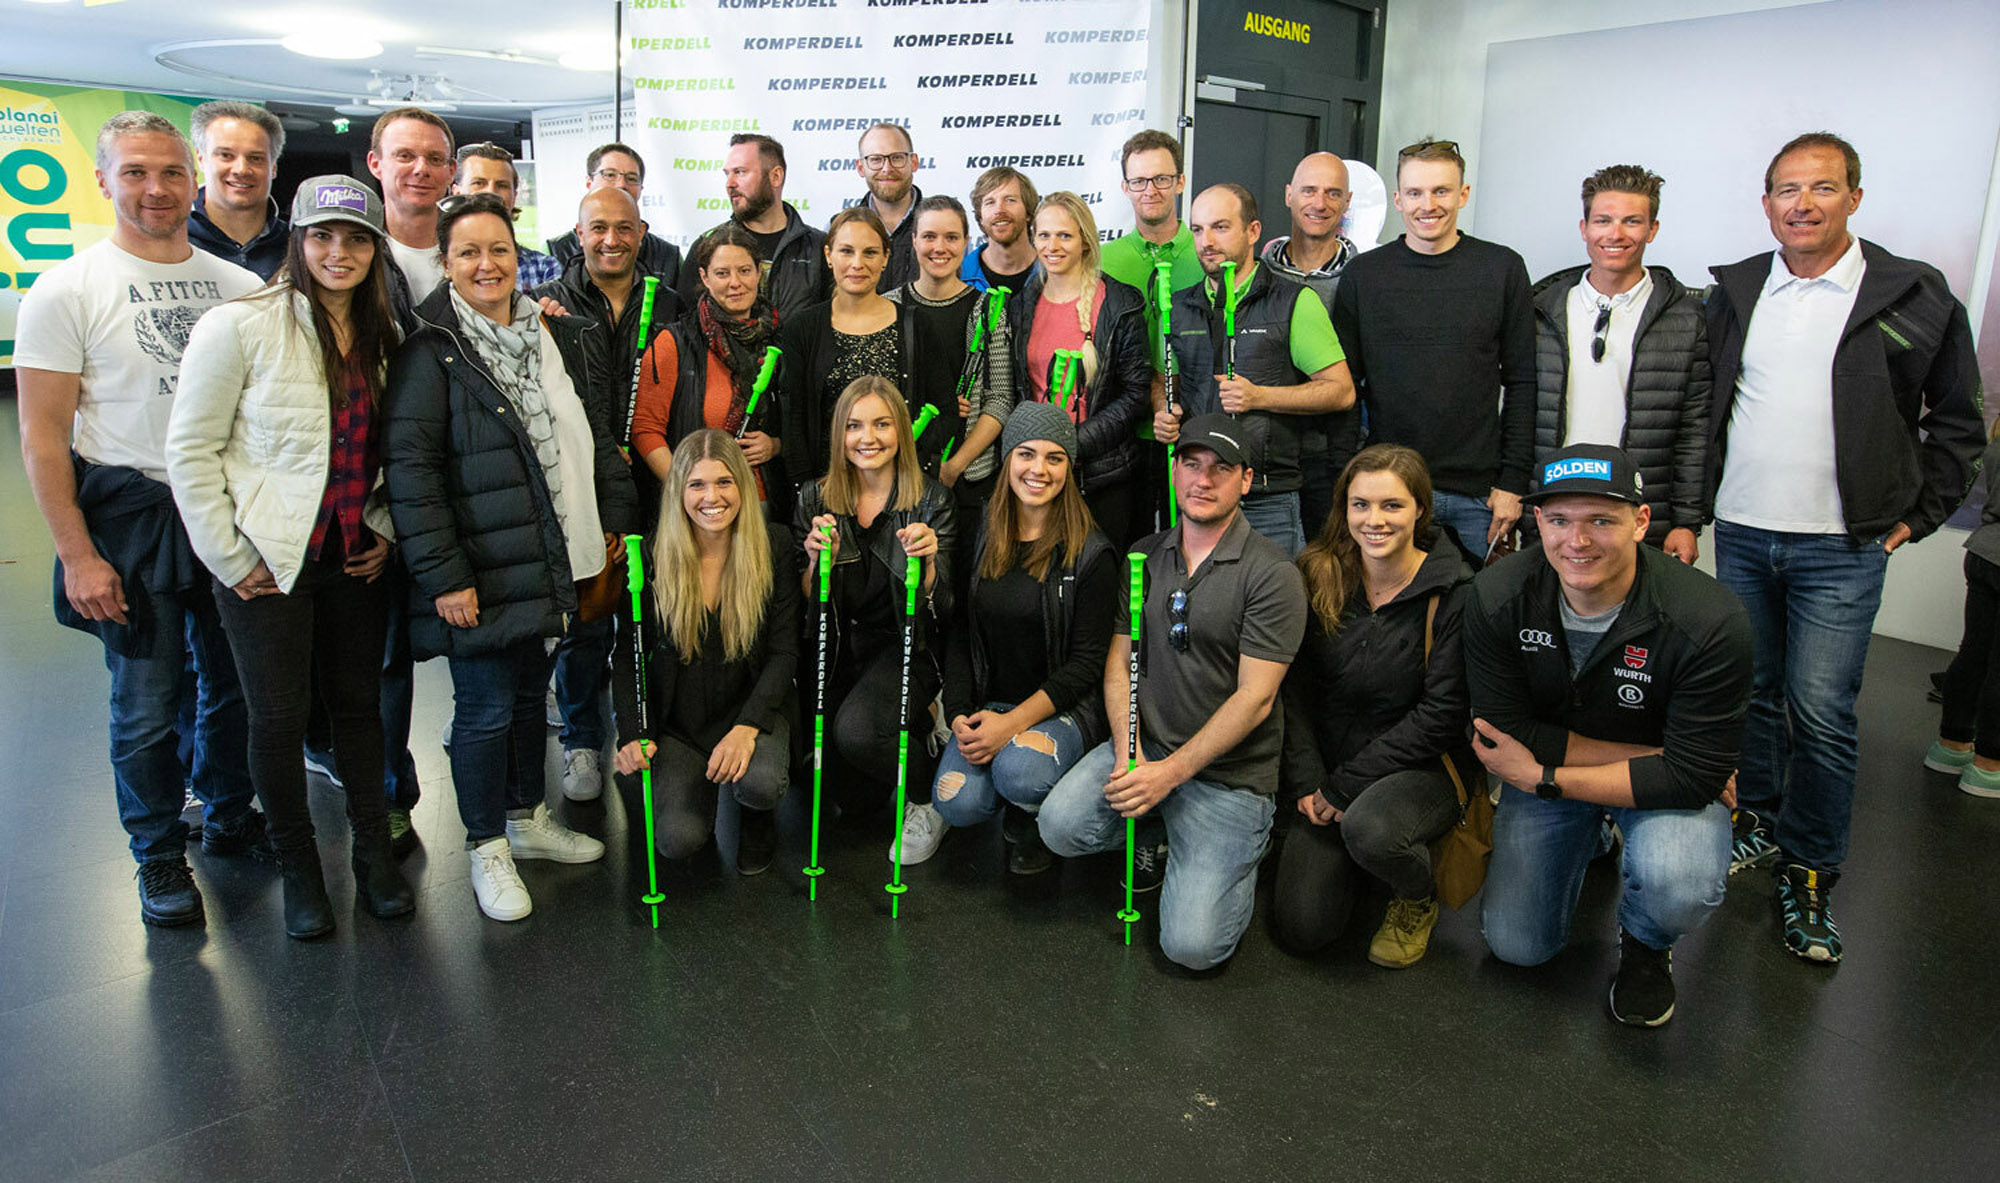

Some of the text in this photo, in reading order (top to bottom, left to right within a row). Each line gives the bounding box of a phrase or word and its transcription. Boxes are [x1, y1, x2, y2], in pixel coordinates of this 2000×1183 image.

[1244, 12, 1311, 44] AUSGANG
[631, 37, 712, 50] PERDELL
[744, 36, 864, 50] KOMPERDELL
[893, 32, 1014, 48] KOMPERDELL
[1045, 29, 1149, 44] KOMPERDE
[634, 77, 735, 91] OMPERDELL
[767, 77, 887, 91] KOMPERDELL
[917, 73, 1038, 89] KOMPERDELL
[1068, 68, 1147, 85] KOMPER
[648, 117, 761, 131] KOMPERDELL
[941, 114, 1062, 129] KOMPERDELL
[966, 154, 1085, 169] KOMPERDELL
[320, 189, 364, 205] Milka
[128, 280, 223, 303] A.FITCH
[624, 358, 642, 442] KOMPERDELL
[1546, 461, 1608, 482] SÖLDEN
[818, 612, 828, 709] KOMPERDELL
[901, 626, 912, 725] KOMPERDELL
[1130, 652, 1138, 753] KOMPERDELL
